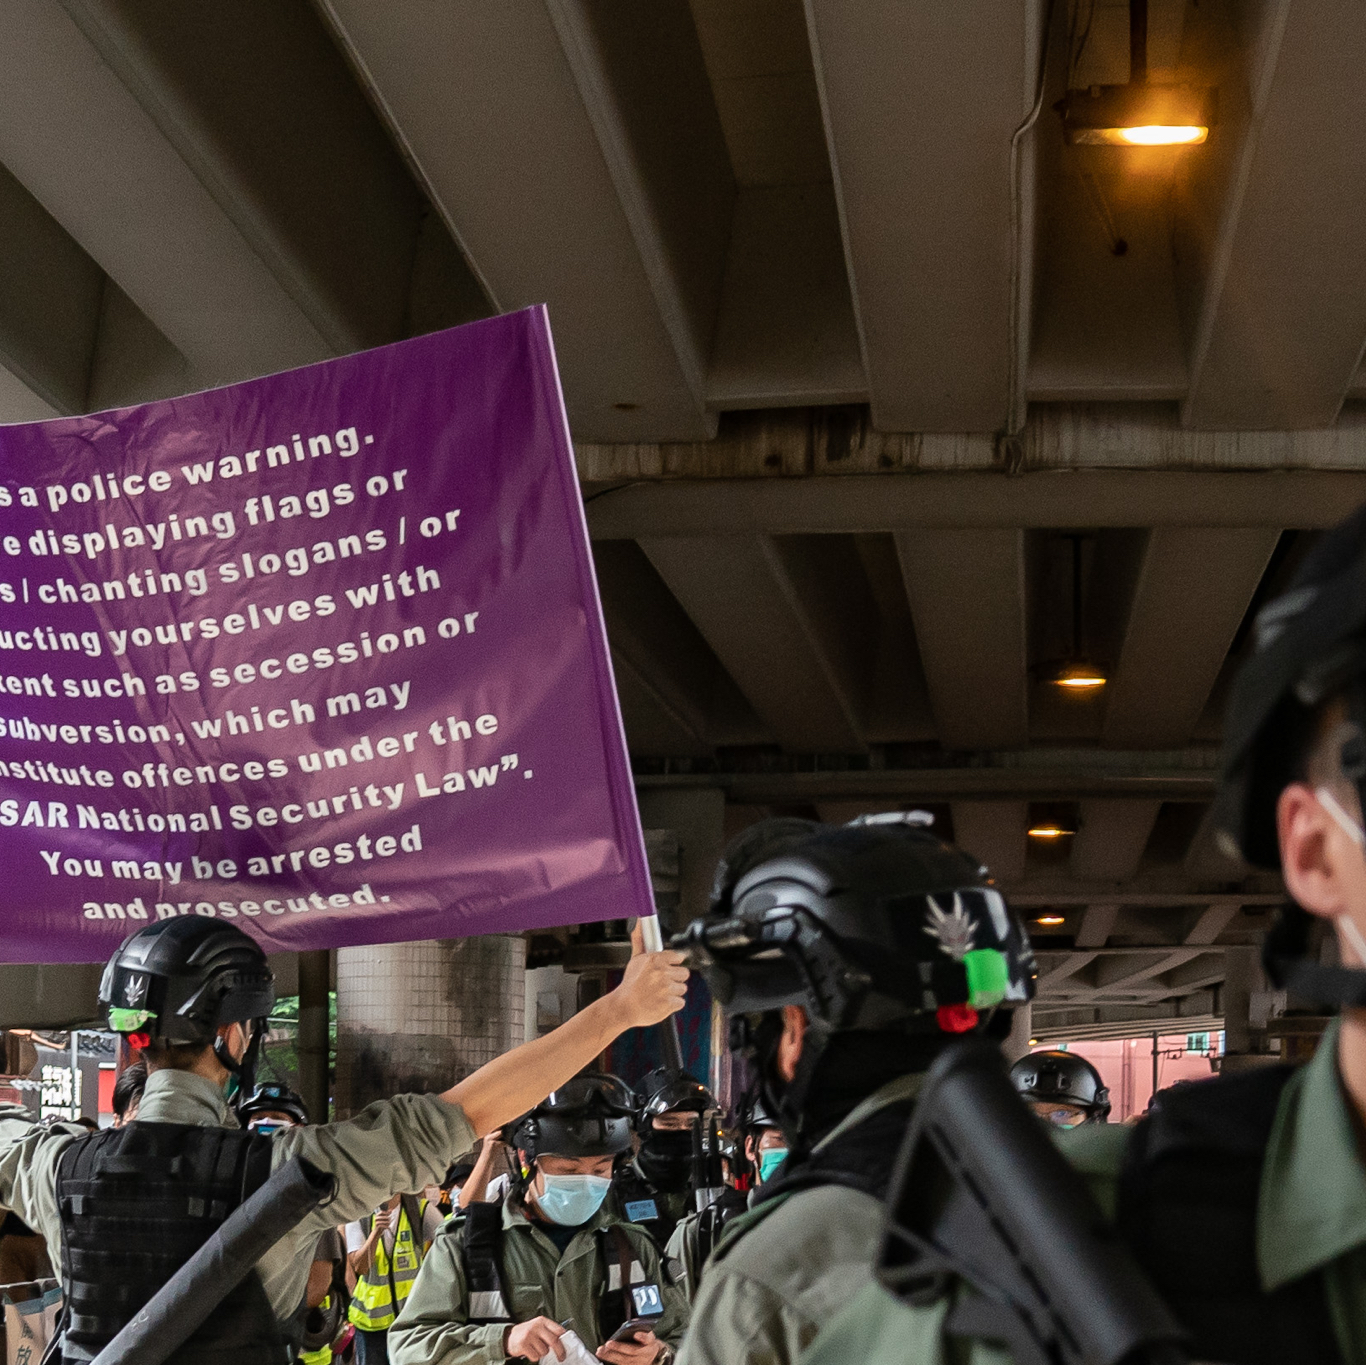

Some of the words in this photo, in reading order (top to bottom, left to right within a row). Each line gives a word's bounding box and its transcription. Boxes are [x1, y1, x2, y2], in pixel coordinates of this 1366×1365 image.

[18, 486, 39, 507] a
[46, 470, 172, 512] police
[180, 426, 374, 485] warning.
[28, 511, 236, 560] displaying
[244, 483, 355, 526] flags
[366, 469, 408, 497] or
[38, 567, 208, 604] chanting
[218, 529, 387, 583] slogans
[419, 509, 461, 538] or
[108, 594, 337, 656] yourselves
[344, 565, 441, 609] with
[62, 672, 146, 698] such
[155, 671, 200, 694] as
[209, 626, 426, 688] secession
[437, 611, 479, 639] or
[190, 698, 316, 739] which
[326, 681, 410, 718] may
[122, 758, 289, 788] offences
[297, 730, 419, 773] under
[428, 714, 498, 746] the
[76, 804, 222, 833] National
[229, 782, 405, 830] Security
[39, 850, 104, 878] You
[111, 860, 182, 885] may
[191, 856, 237, 879] be
[247, 824, 423, 875] arrested
[82, 897, 149, 920] and
[155, 885, 392, 922] prosecuted.
